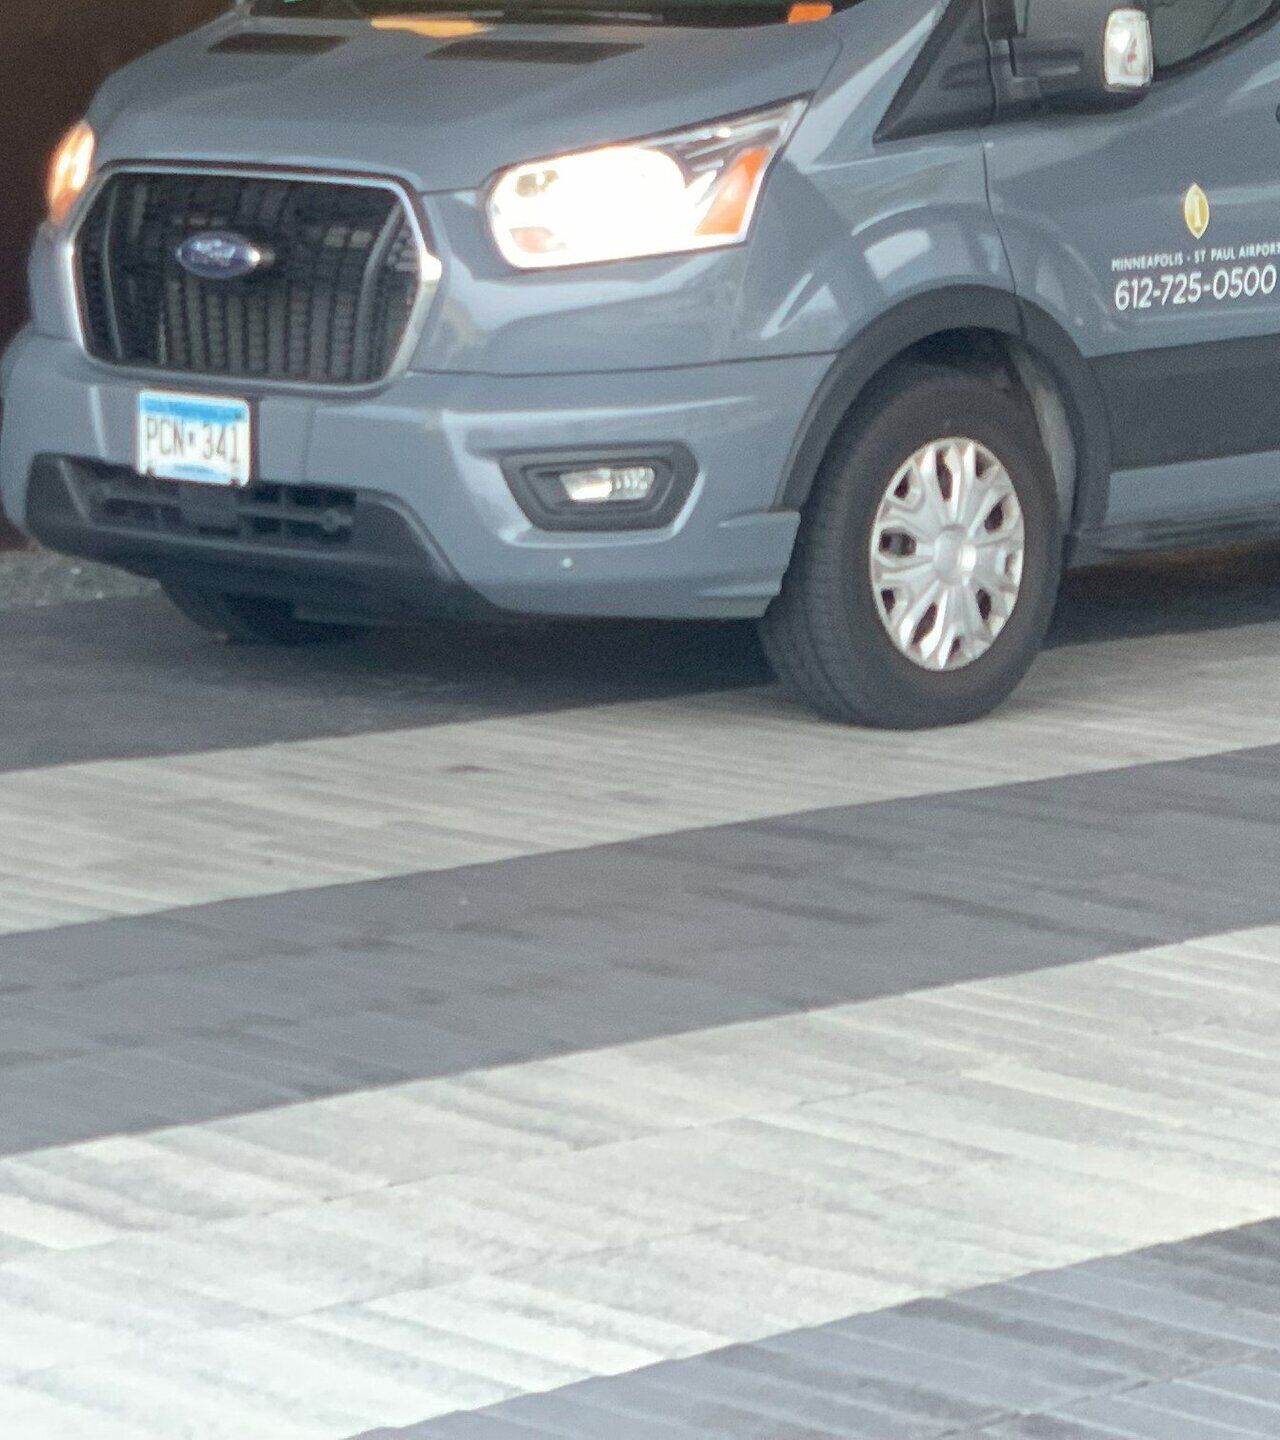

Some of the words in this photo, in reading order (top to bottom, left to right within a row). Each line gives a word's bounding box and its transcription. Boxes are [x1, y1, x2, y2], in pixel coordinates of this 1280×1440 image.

[1111, 252, 1184, 272] MINNEAPOLIS
[1194, 249, 1207, 265] ST
[1210, 245, 1236, 262] PAUL
[1114, 262, 1278, 312] 612-725-0500
